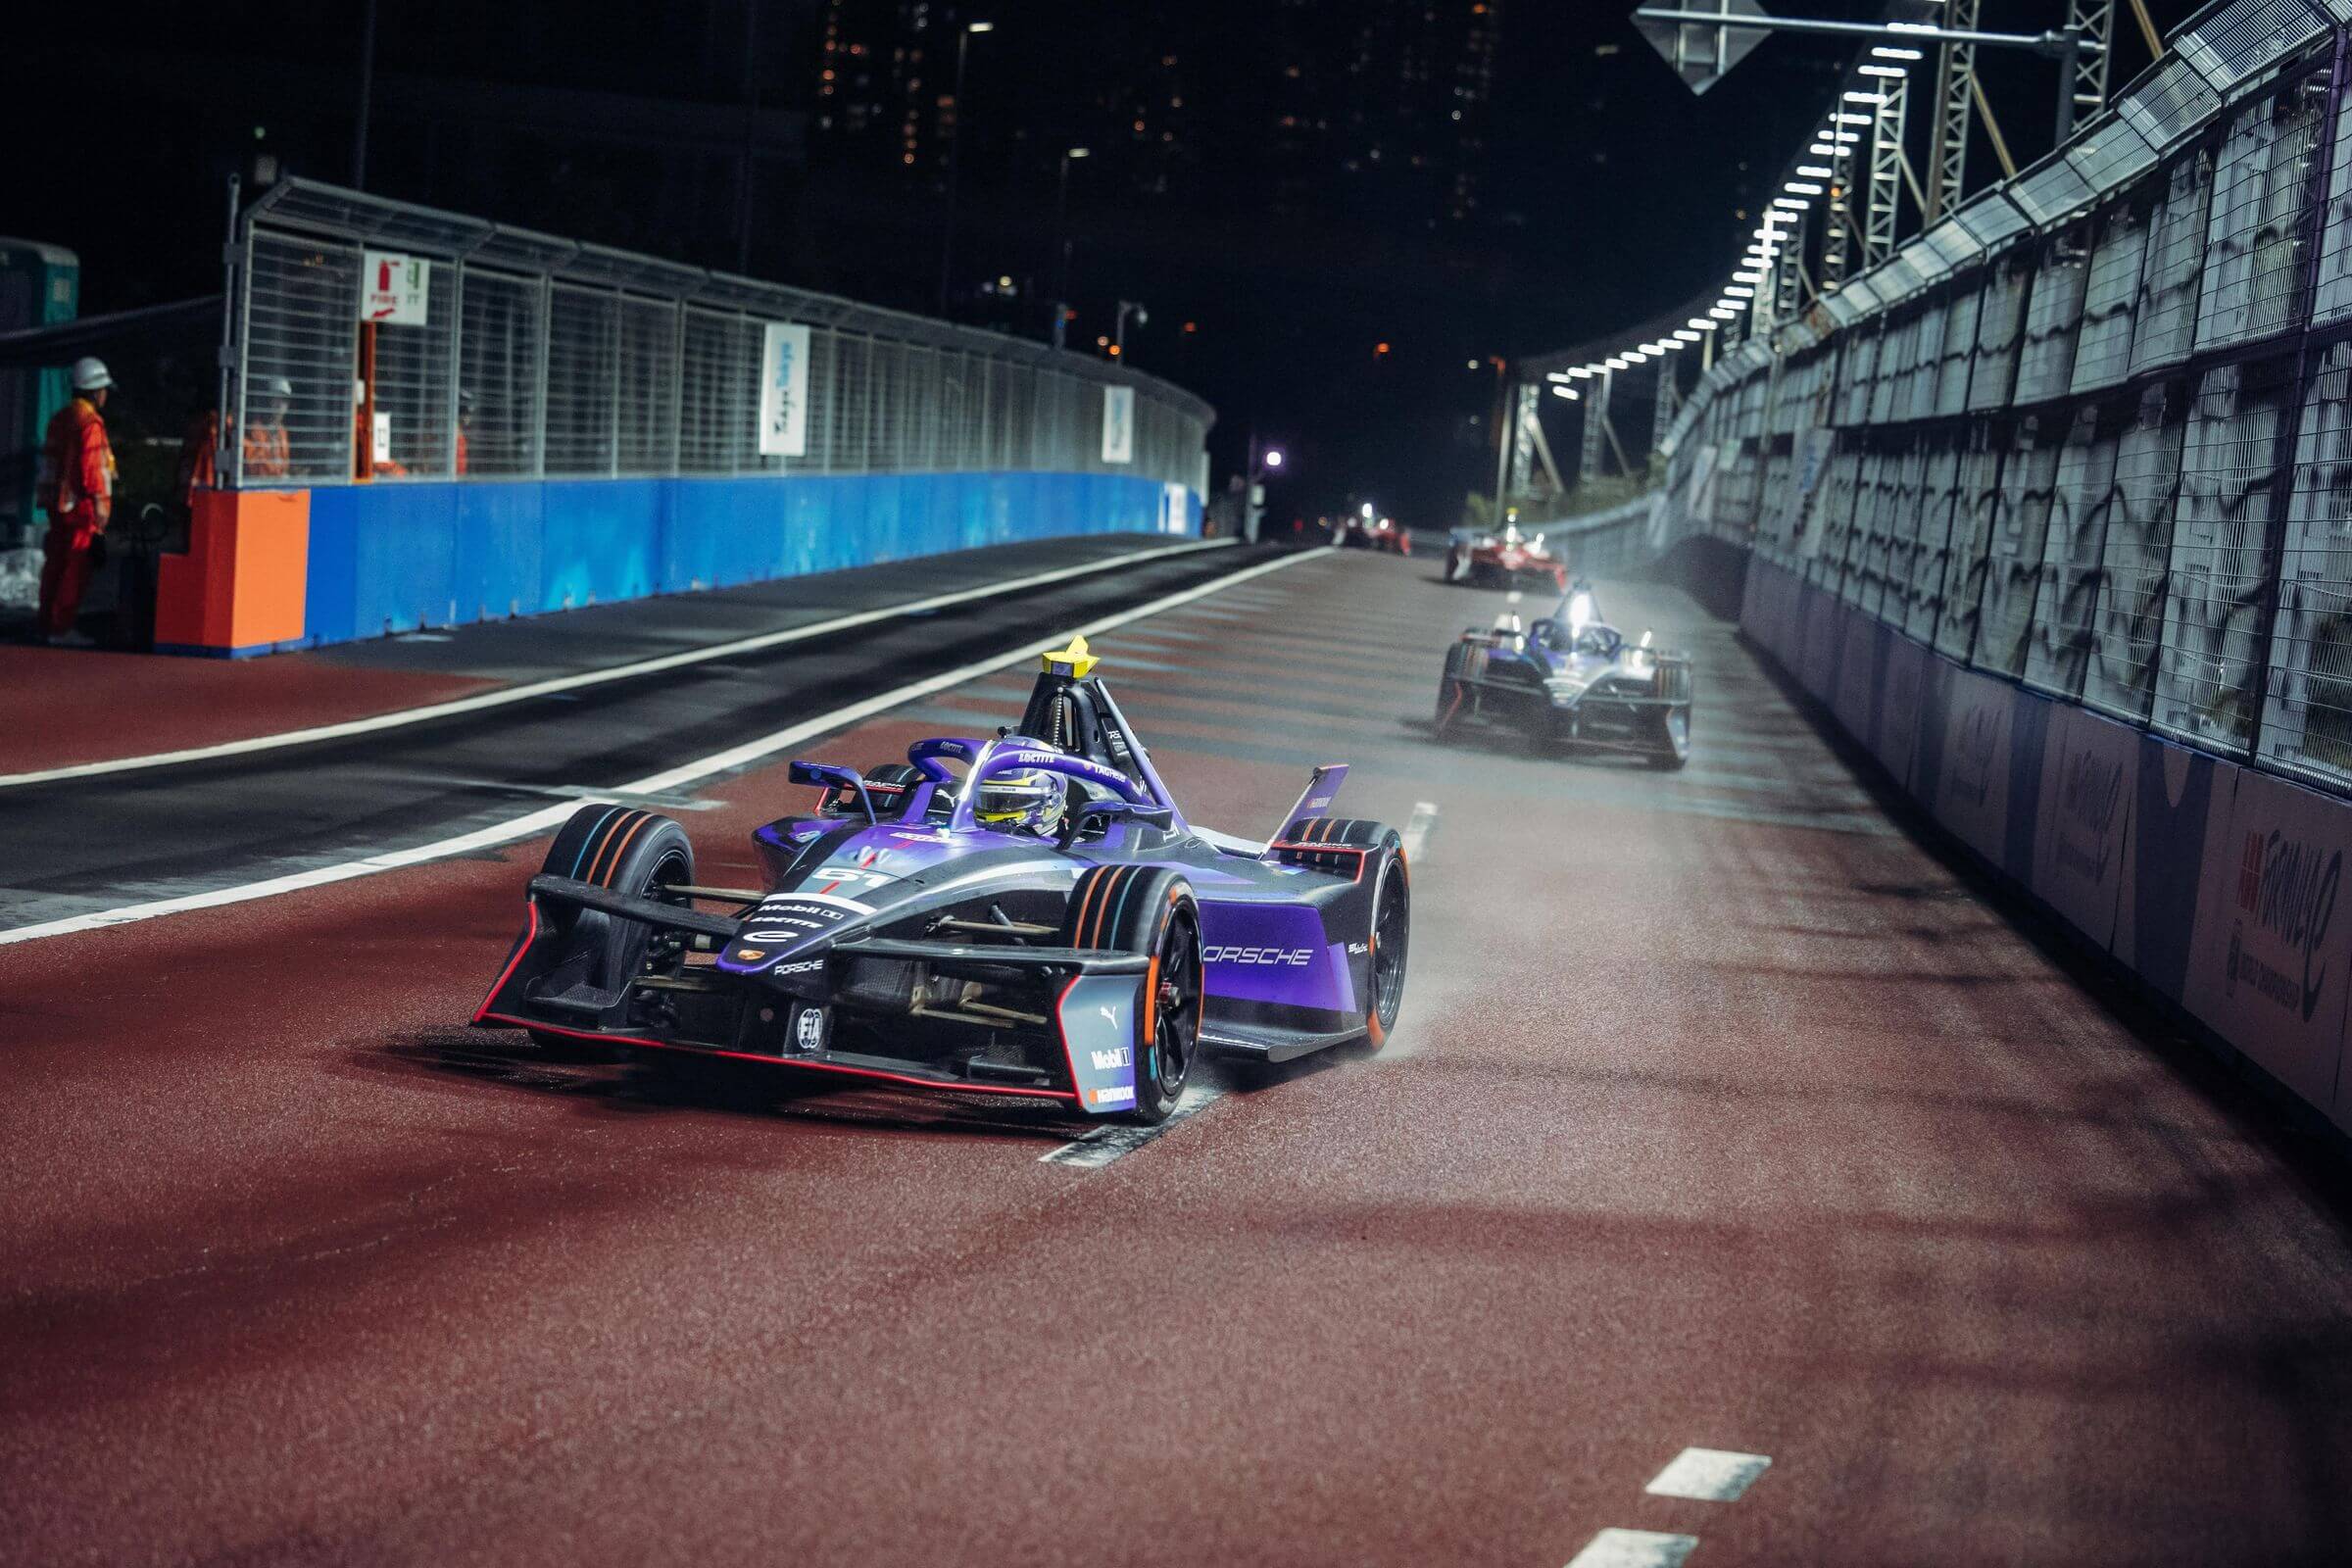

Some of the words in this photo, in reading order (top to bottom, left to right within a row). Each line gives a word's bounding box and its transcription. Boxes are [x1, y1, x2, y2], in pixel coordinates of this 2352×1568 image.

[1018, 753, 1054, 763] LOCTITE
[812, 867, 890, 888] 51
[758, 905, 821, 914] Mobil
[1202, 946, 1314, 965] ORSCHE
[774, 959, 824, 976] PORSCHE
[800, 1017, 820, 1040] FIA
[1091, 1048, 1122, 1070] Mobil
